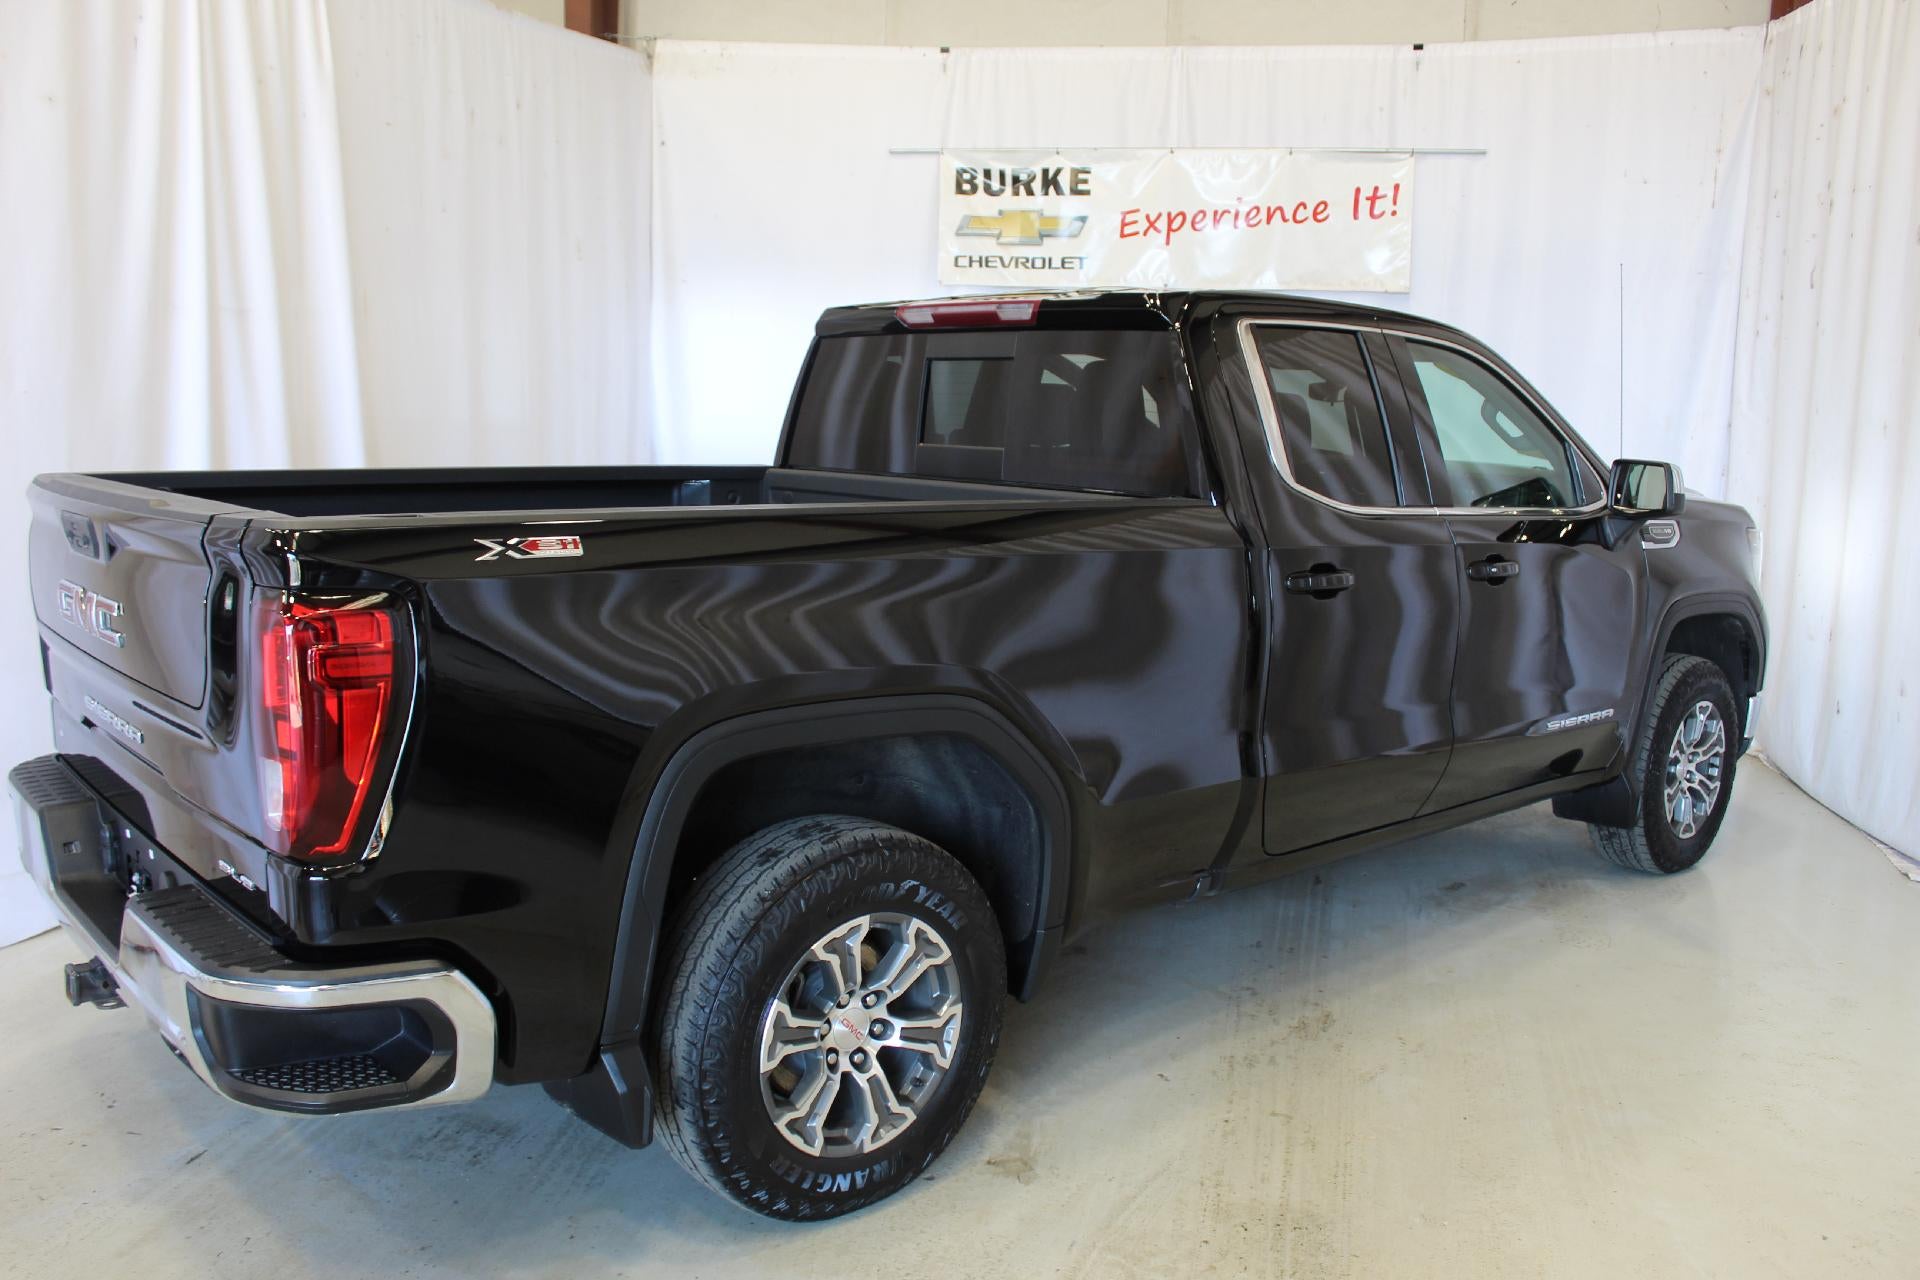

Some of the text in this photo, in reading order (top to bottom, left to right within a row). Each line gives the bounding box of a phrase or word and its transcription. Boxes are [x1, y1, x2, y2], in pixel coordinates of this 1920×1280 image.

[955, 167, 1092, 197] BURKE
[1119, 183, 1401, 246] Experience It!
[954, 255, 1088, 270] CHEVROLET
[58, 579, 126, 648] GMC
[1545, 708, 1615, 732] SIERRA
[841, 1018, 863, 1040] GMC
